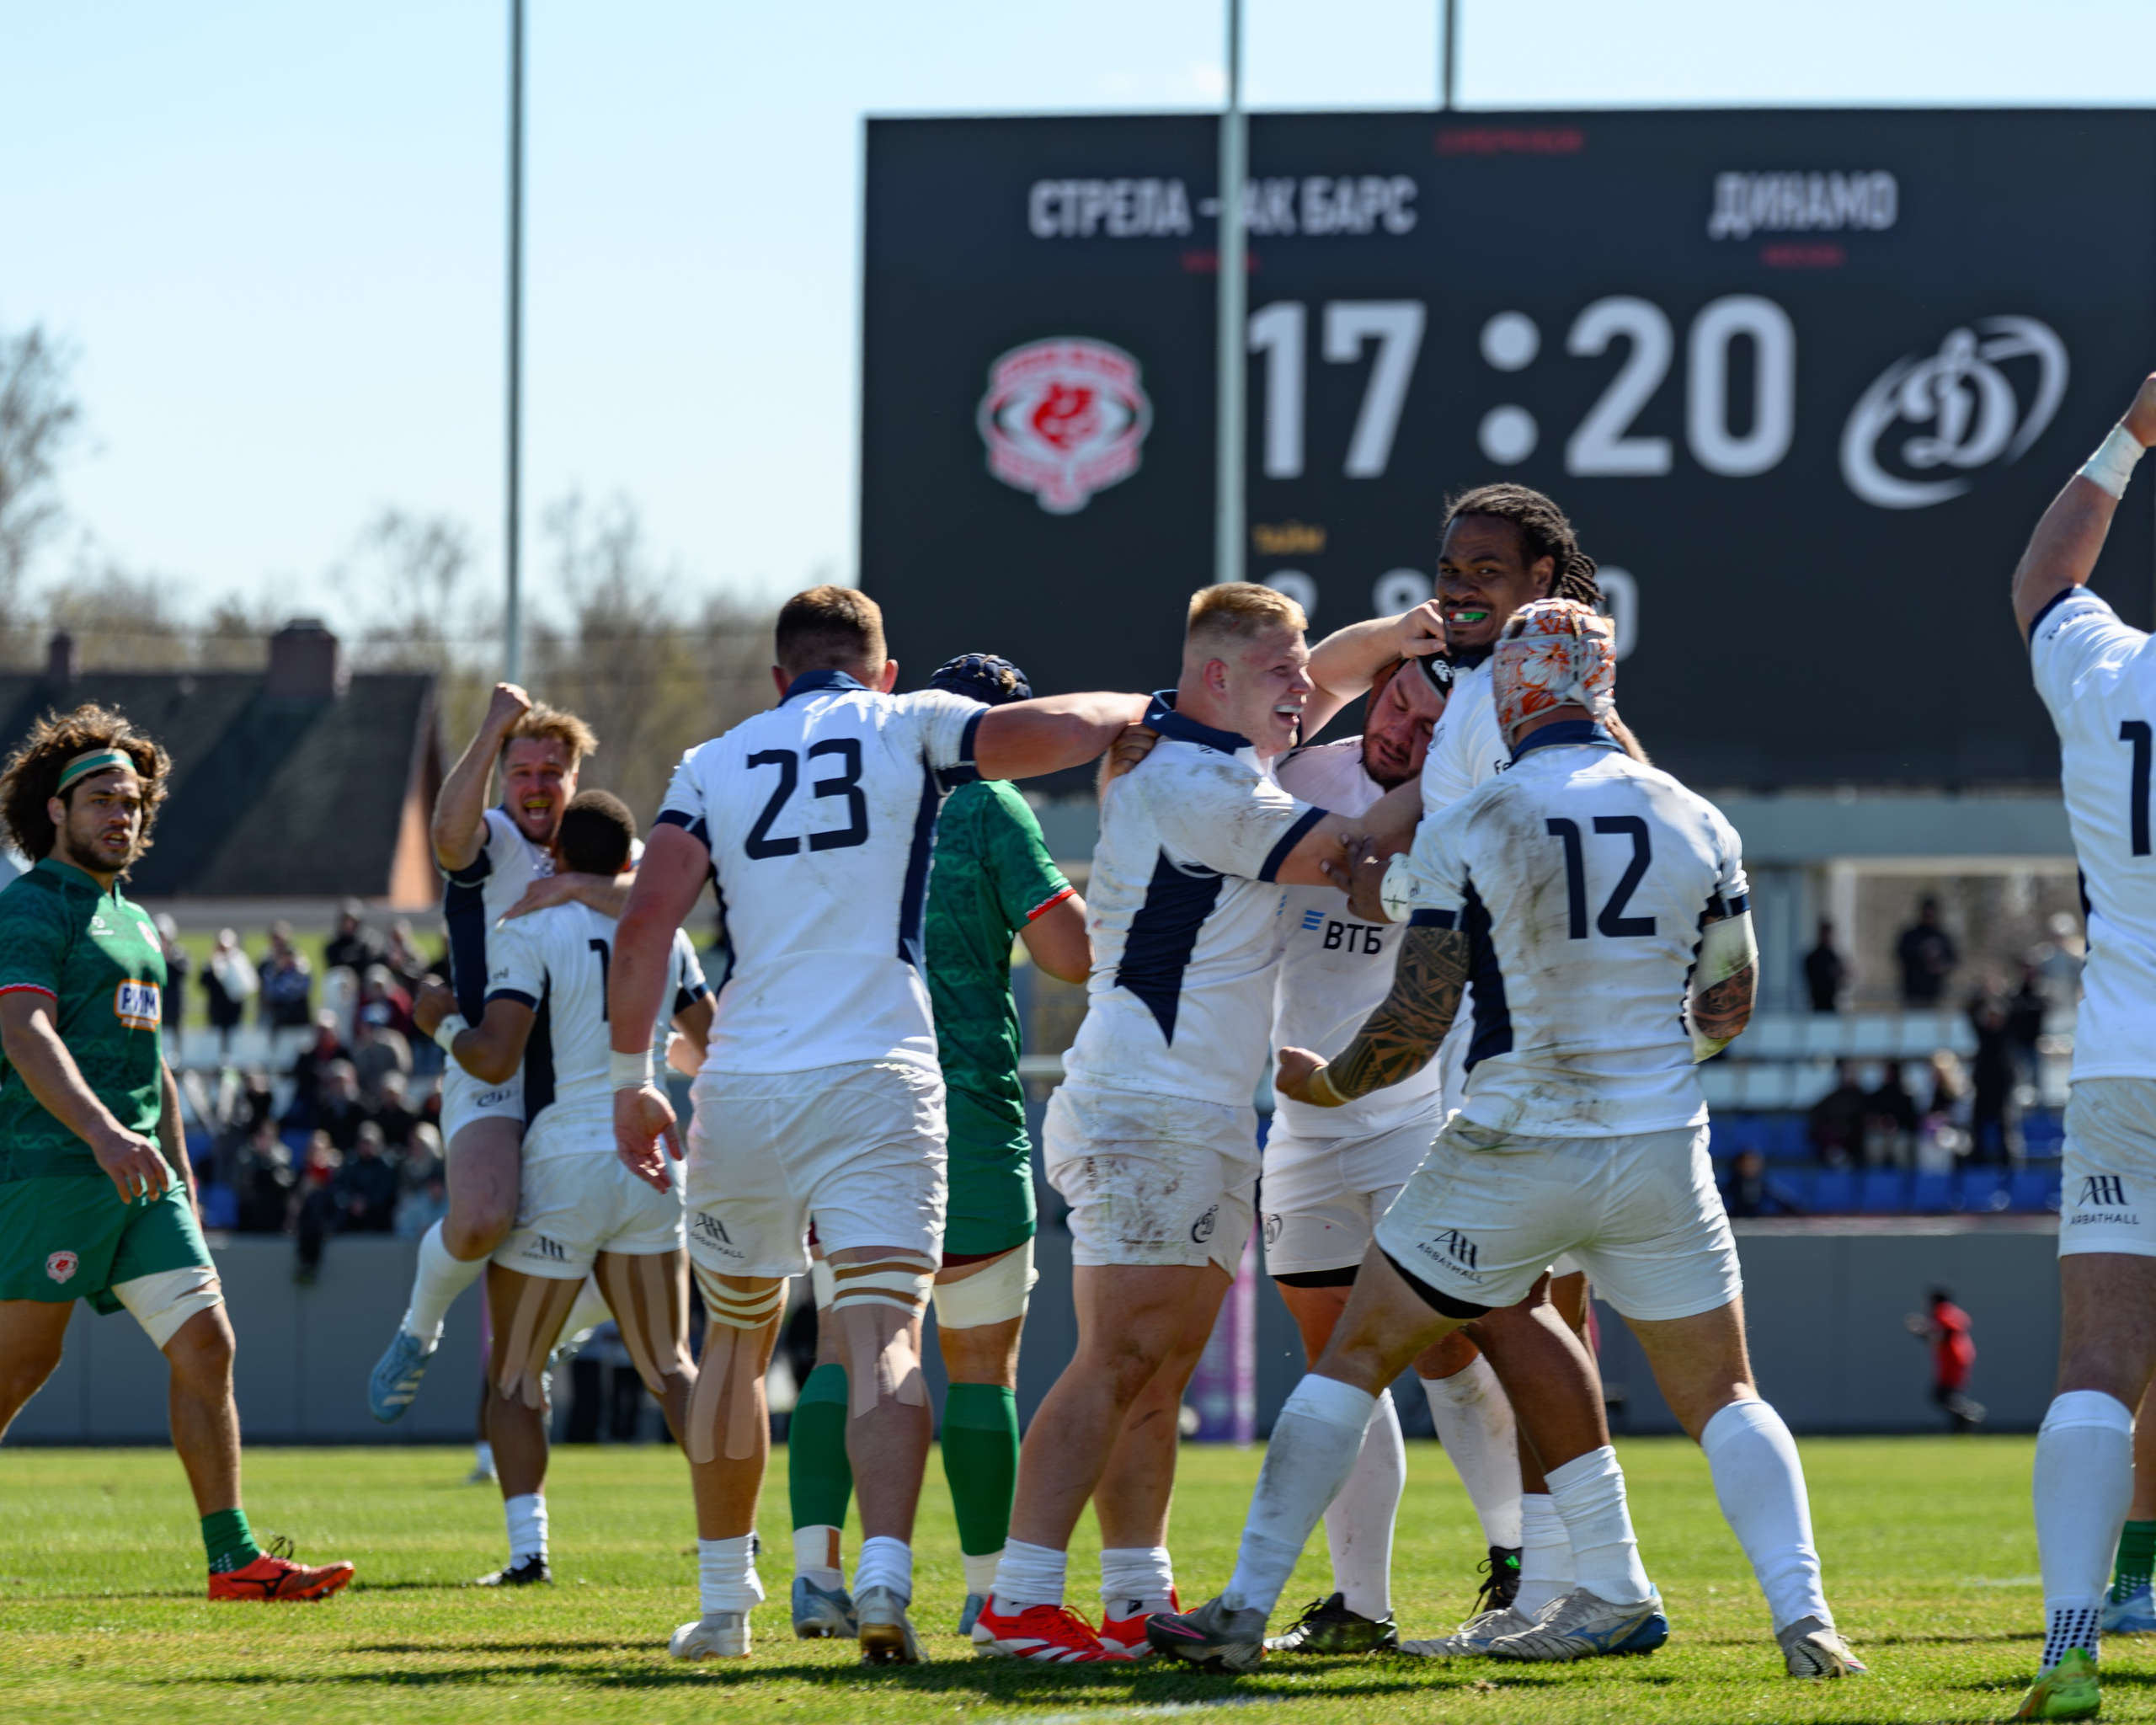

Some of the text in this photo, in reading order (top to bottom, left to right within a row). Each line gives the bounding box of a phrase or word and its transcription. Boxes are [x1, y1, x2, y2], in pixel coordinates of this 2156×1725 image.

[1028, 179, 1193, 238] СТРЕЛА
[1299, 174, 1418, 236] БАРС
[1707, 170, 1897, 241] ДИНАМО
[1247, 299, 1427, 479] 17
[1564, 295, 1796, 477] 20
[744, 738, 869, 860] 23
[1545, 815, 1657, 940] 12
[1322, 920, 1385, 955] ВТБ
[2068, 1213, 2141, 1226] ARBATHALL
[1417, 1242, 1485, 1284] ARBATHALL
